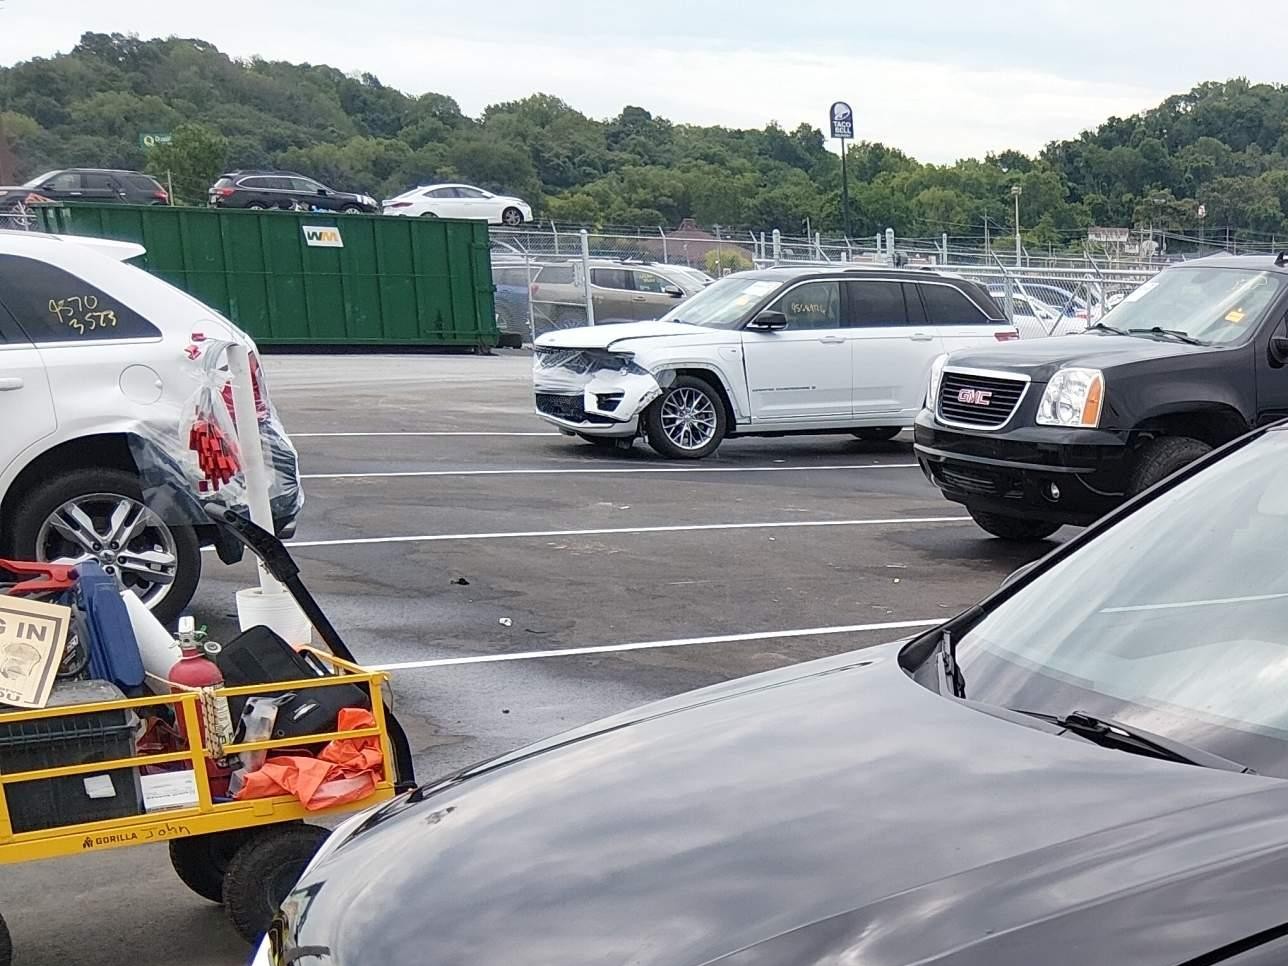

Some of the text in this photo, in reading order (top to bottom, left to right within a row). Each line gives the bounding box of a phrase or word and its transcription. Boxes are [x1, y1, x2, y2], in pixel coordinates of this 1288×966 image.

[306, 231, 338, 241] WM
[48, 295, 98, 323] 4570
[958, 388, 992, 406] GMC
[16, 622, 47, 642] IN
[95, 832, 138, 845] GORILLA
